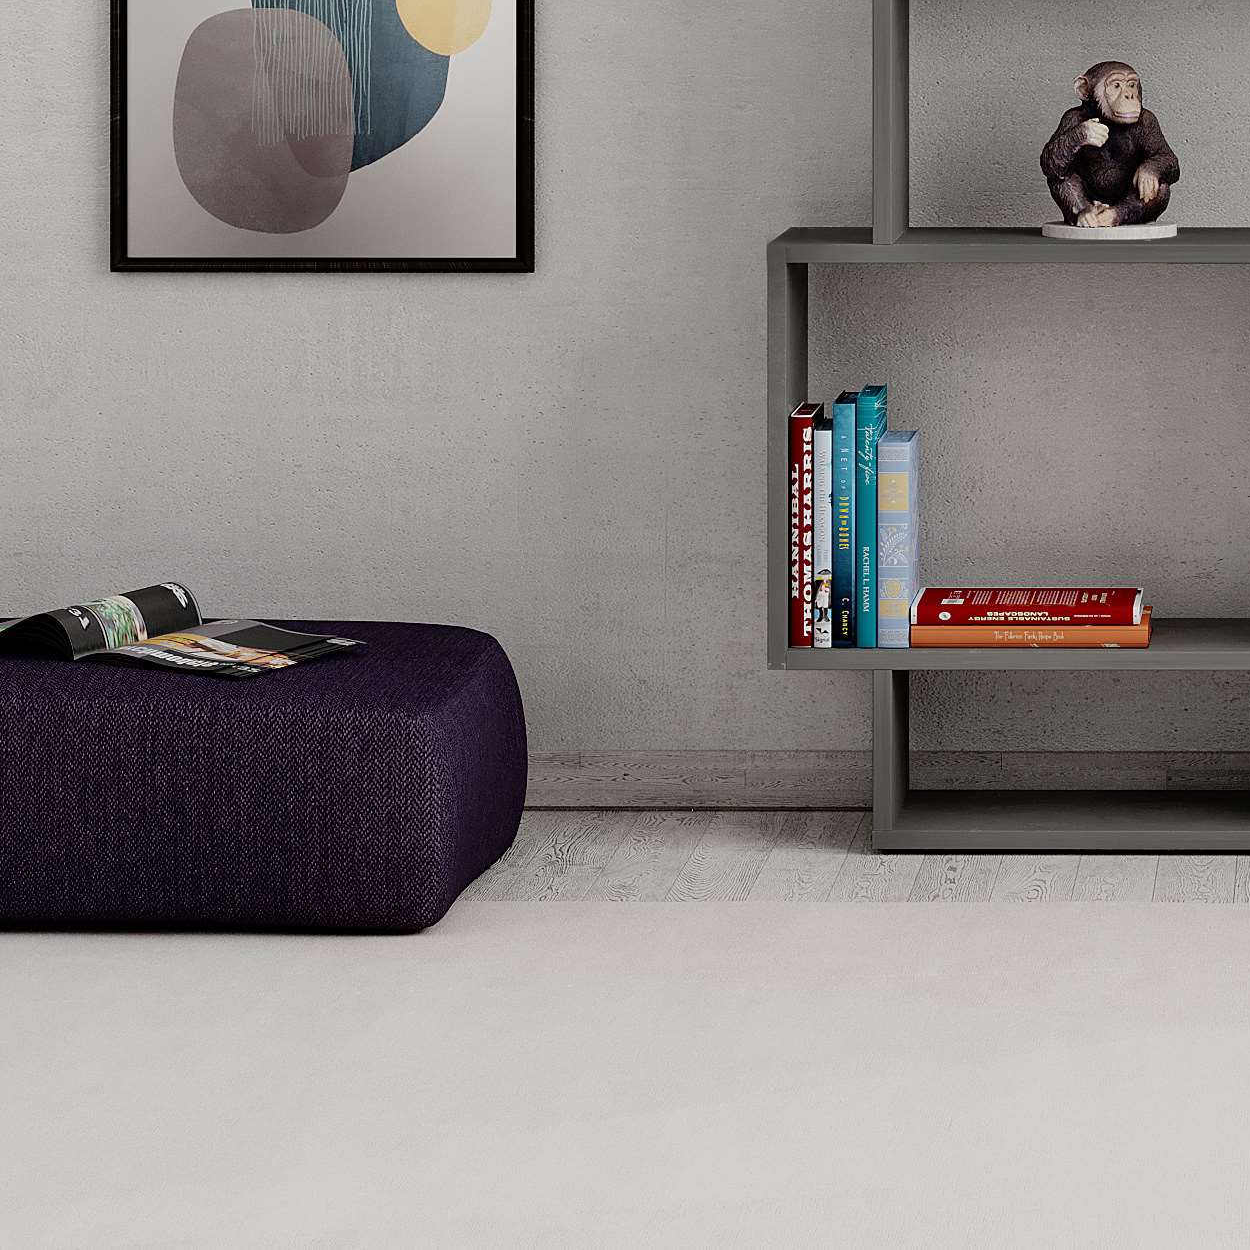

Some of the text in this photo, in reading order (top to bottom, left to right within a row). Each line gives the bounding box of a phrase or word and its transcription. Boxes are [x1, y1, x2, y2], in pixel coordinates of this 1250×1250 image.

[840, 448, 849, 471] NET
[791, 464, 799, 598] HANNIBAL
[803, 426, 812, 636] THOMAS HARRIS
[862, 546, 870, 577] RACHEL
[862, 586, 870, 612] HAMM
